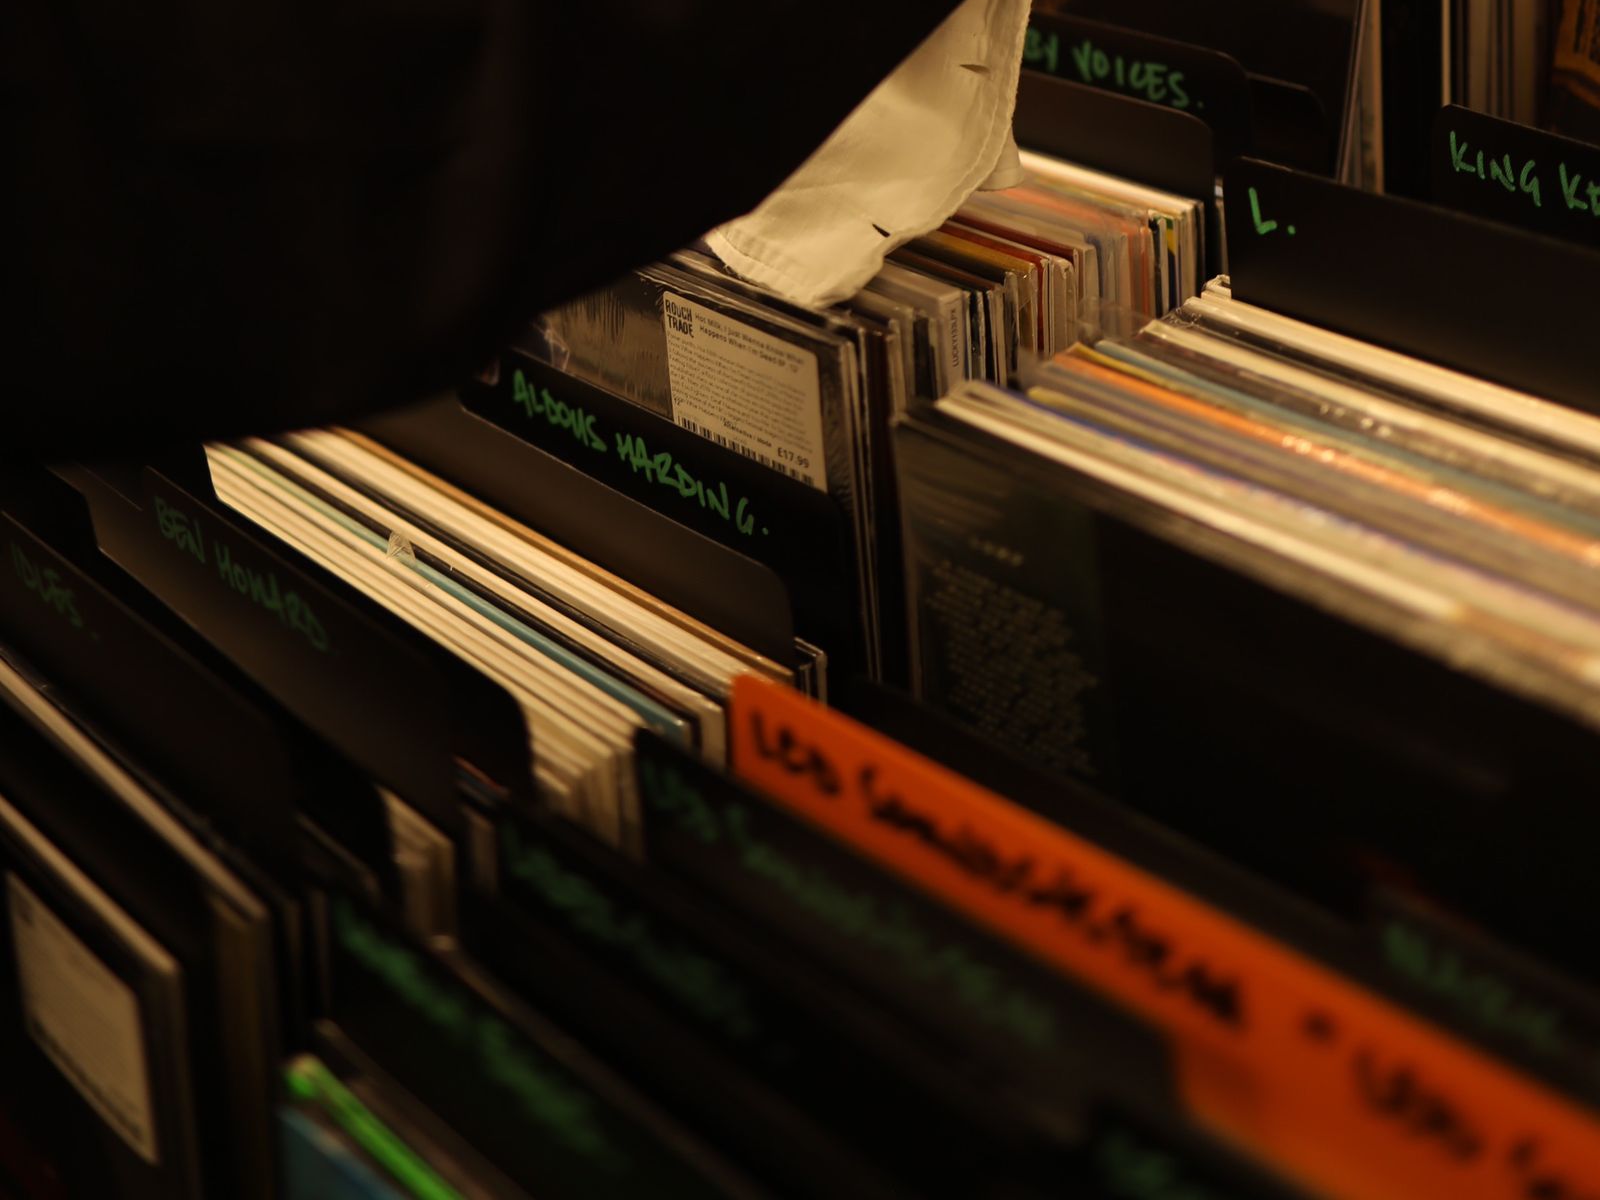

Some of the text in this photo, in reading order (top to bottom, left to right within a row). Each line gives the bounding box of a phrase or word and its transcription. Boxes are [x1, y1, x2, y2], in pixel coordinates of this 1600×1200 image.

[1450, 130, 1542, 208] KING
[667, 314, 694, 339] TRADE
[513, 368, 607, 453] ALDOUS
